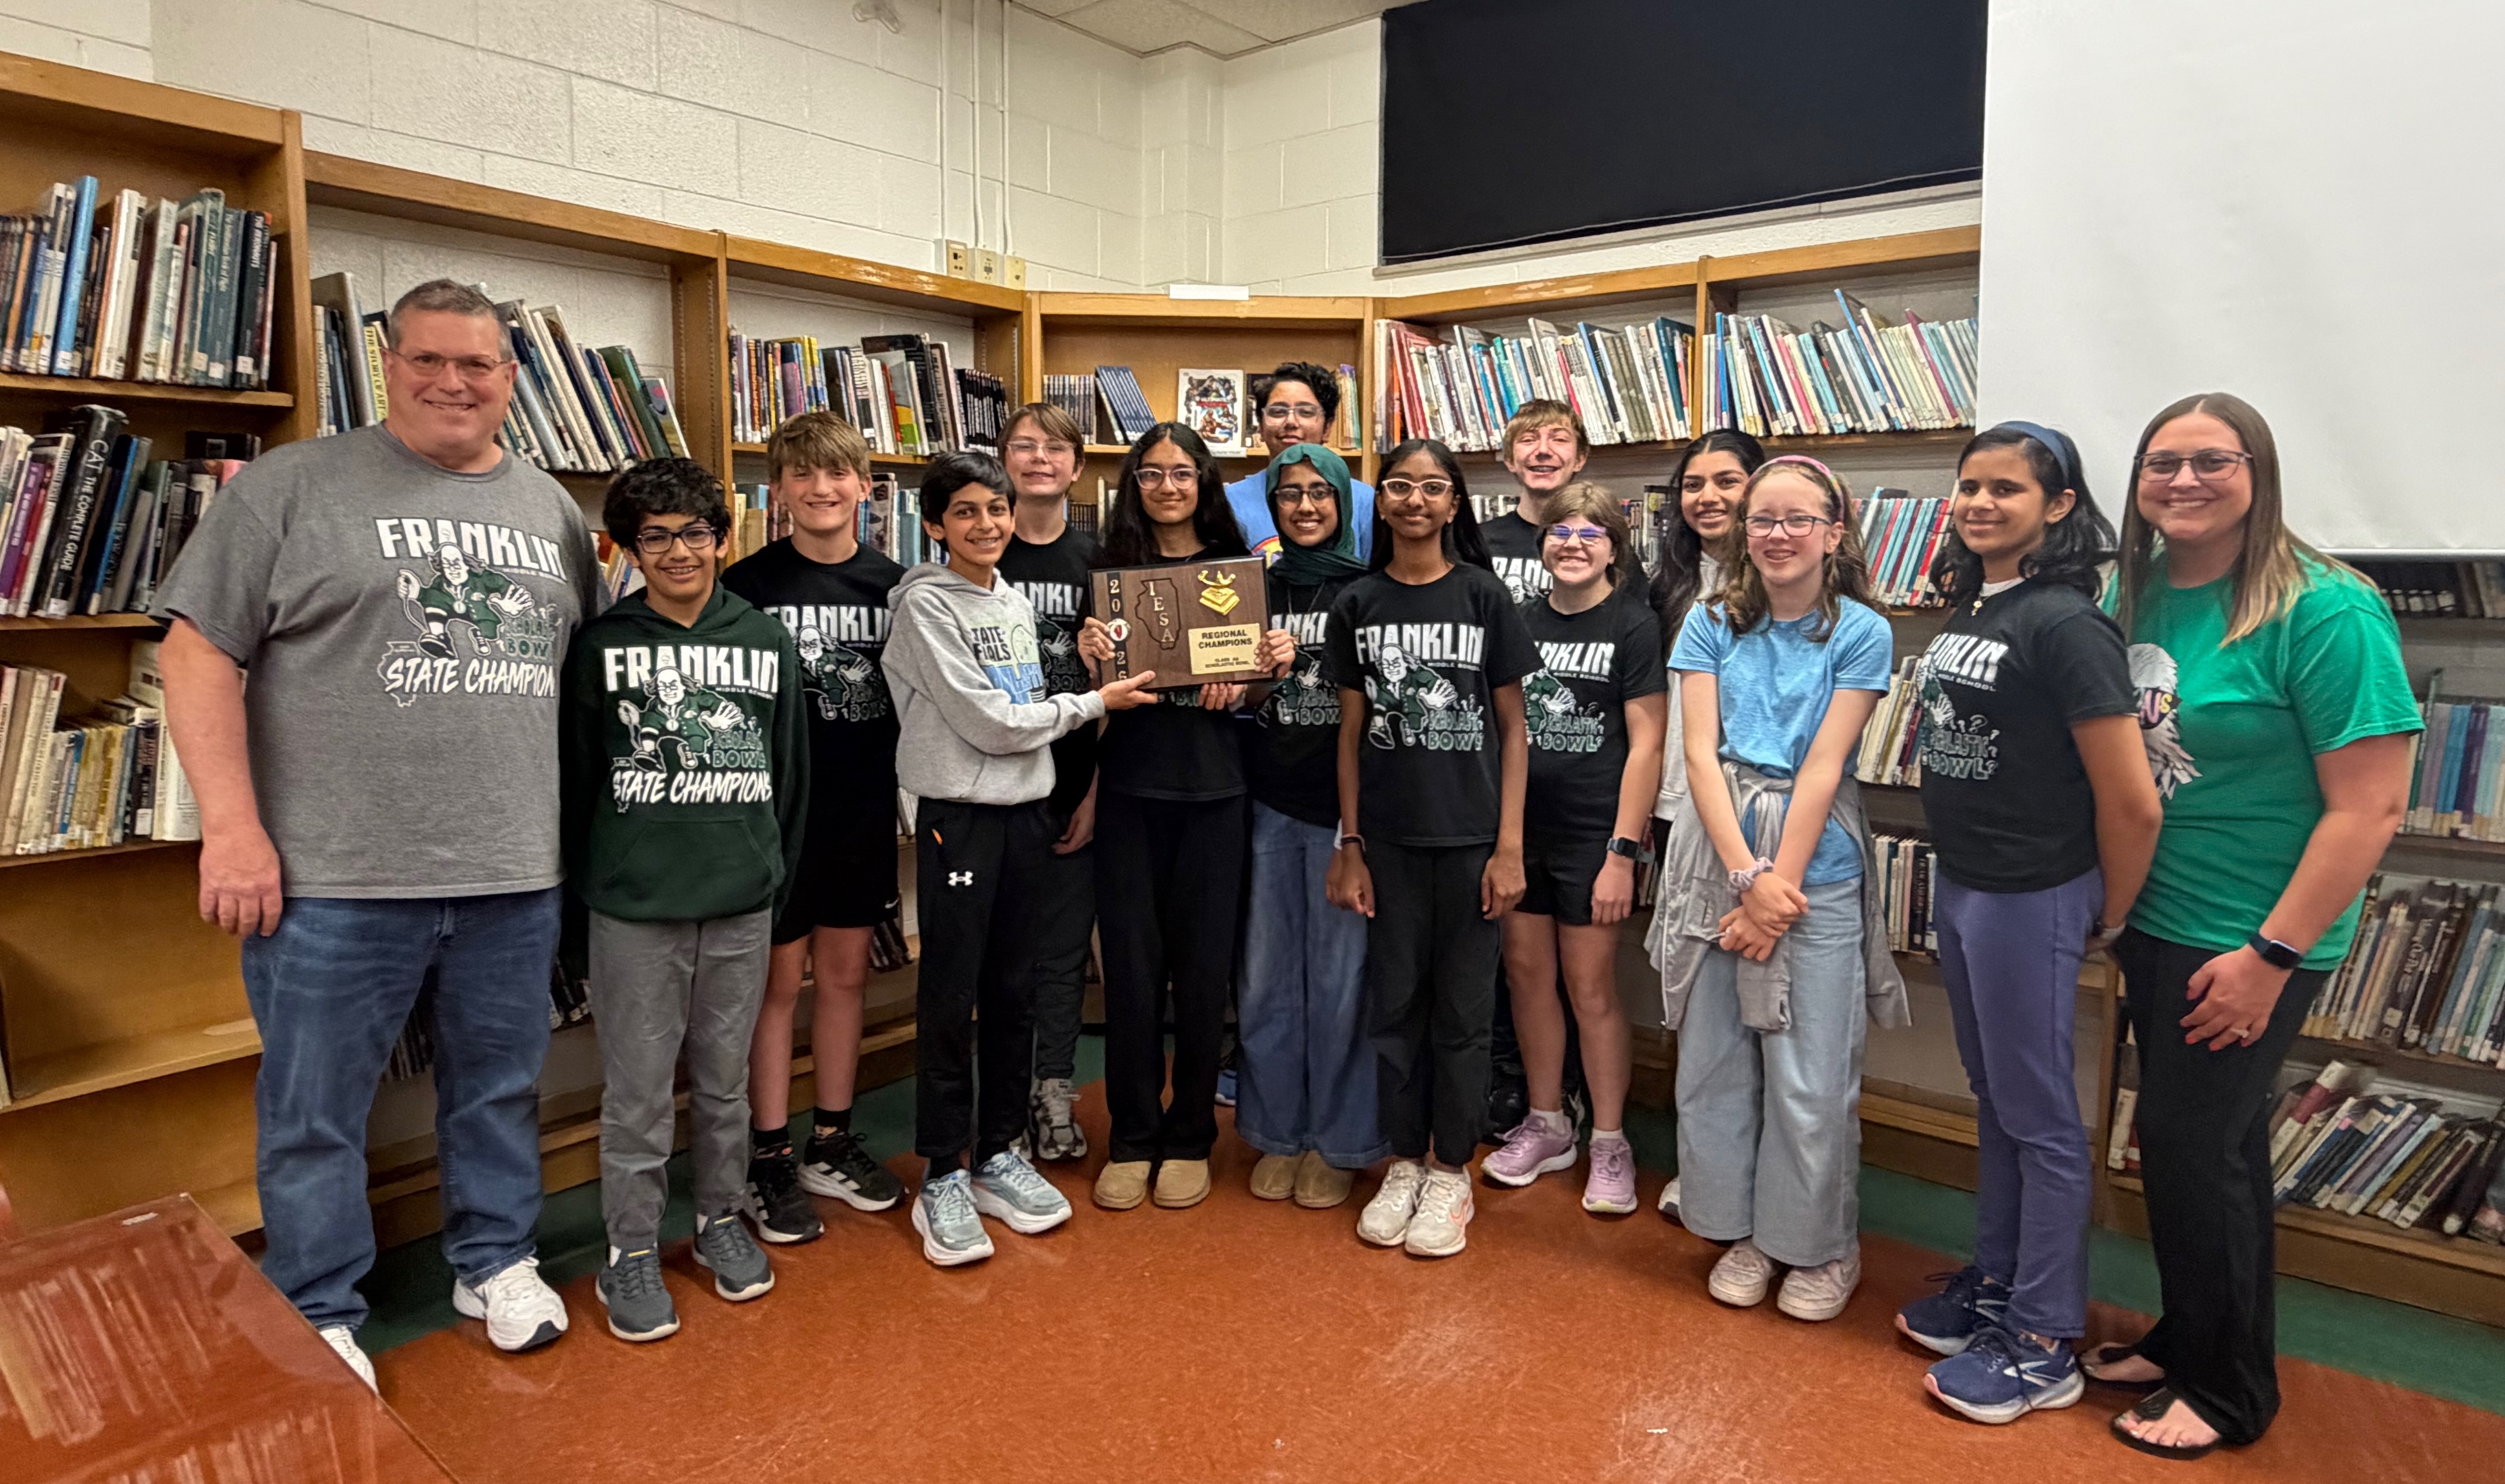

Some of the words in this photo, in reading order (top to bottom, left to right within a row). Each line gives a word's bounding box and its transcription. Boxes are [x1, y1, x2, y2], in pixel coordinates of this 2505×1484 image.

[365, 330, 375, 347] THE
[368, 349, 380, 378] STORY
[374, 380, 382, 391] OF
[375, 392, 387, 409] ART
[85, 439, 109, 474] CAT
[80, 476, 96, 496] THE
[68, 494, 94, 542] COMPLETE
[60, 539, 79, 571] GUIDE
[375, 518, 567, 582] FRANKLIN
[1198, 638, 1253, 649] CHAMPIONS
[1202, 629, 1247, 639] REGIONAL
[1355, 623, 1485, 665] FRANKLIN
[604, 645, 779, 692] FRANKLIN
[1535, 641, 1616, 676] NKLIN
[385, 658, 460, 694] STATE
[1955, 677, 1996, 692] SCHOOL
[1542, 733, 1599, 752] BOWL
[612, 770, 668, 804] STATE
[670, 771, 773, 804] CHAMPIONS
